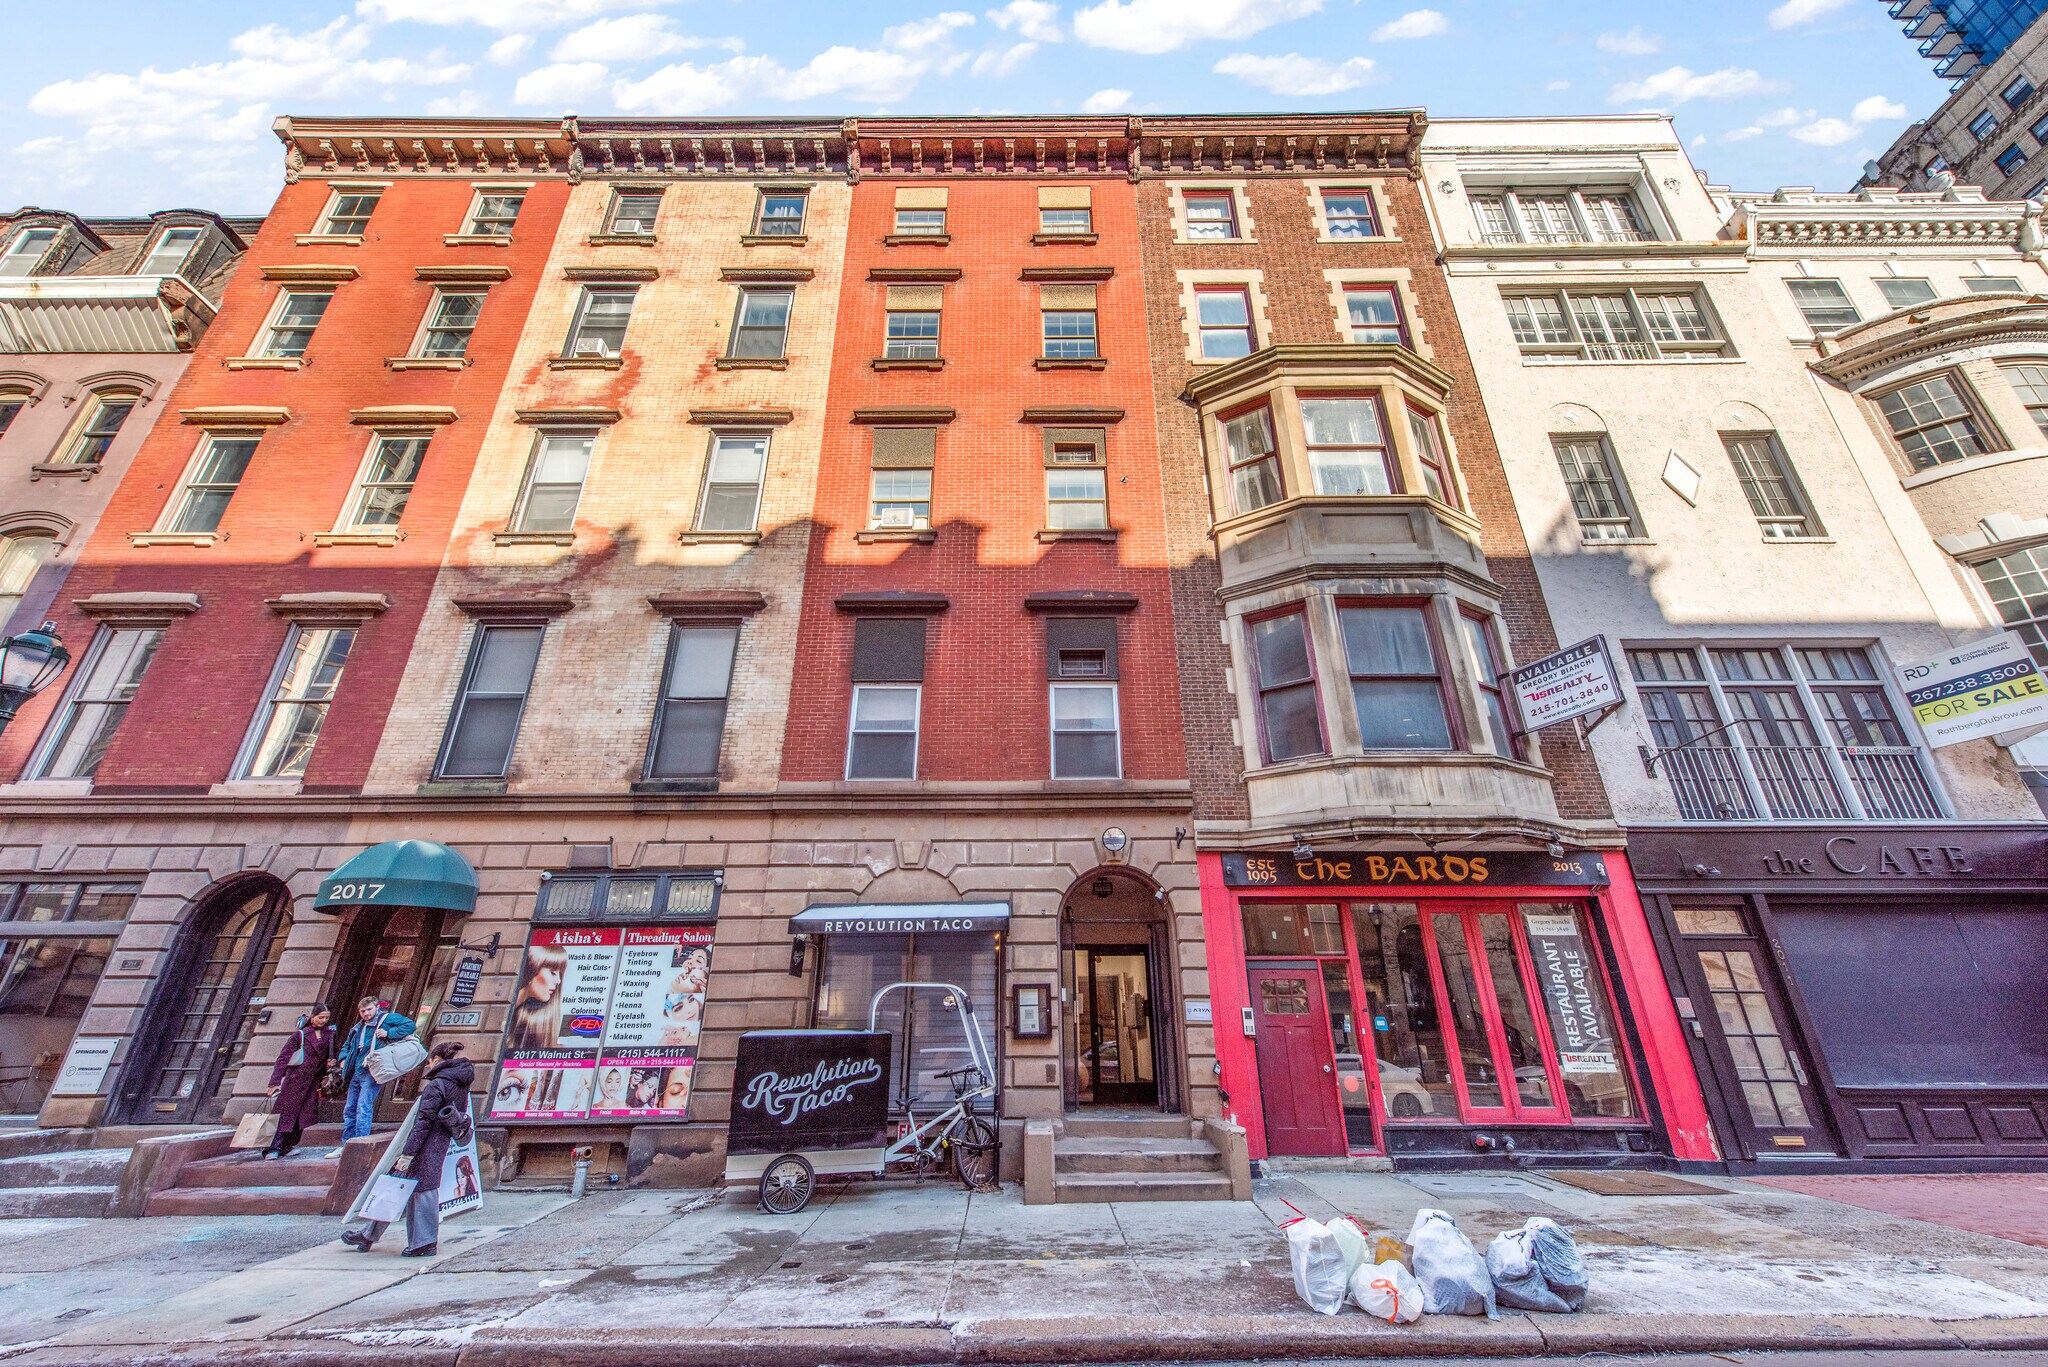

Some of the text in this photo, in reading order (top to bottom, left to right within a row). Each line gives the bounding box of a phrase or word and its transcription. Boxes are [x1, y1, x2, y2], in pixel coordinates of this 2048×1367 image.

[1962, 646, 2010, 662] COMMERCIAL
[1518, 646, 1592, 682] AVAILABLE
[1522, 658, 1595, 690] GREGORY BIANCHI
[1911, 663, 2030, 704] 267.238.3500
[1524, 672, 1604, 701] USREALTY
[1530, 683, 1609, 717] 215-701-3840
[1542, 698, 1596, 720] www.eusrealty.com
[1918, 679, 2042, 722] FOR SALE
[1937, 705, 2043, 736] RothbergDubrow.com
[1762, 836, 1973, 875] the CAFE
[1247, 870, 1277, 884] 1995
[1366, 854, 1489, 884] BARDS
[1553, 862, 1583, 875] 2013
[329, 884, 386, 900] 2017
[825, 919, 973, 932] REVOLUTION TACO
[550, 932, 602, 944] Aisha's
[628, 932, 711, 944] Threading Salon
[1772, 939, 1794, 986] 2011
[625, 969, 661, 977] Threading
[578, 996, 602, 1004] Styling
[1542, 939, 1583, 1047] RESTAURANT
[1564, 950, 1600, 1039] AVAILABLE
[445, 1014, 475, 1024] 2017
[571, 1007, 599, 1015] Coloring
[570, 1019, 603, 1030] OPEN
[613, 1033, 642, 1041] Makeup
[574, 1051, 586, 1059] St.
[617, 1048, 685, 1058] (215) 544-1117
[742, 1058, 882, 1115] Revolution
[774, 1084, 847, 1124] Taco
